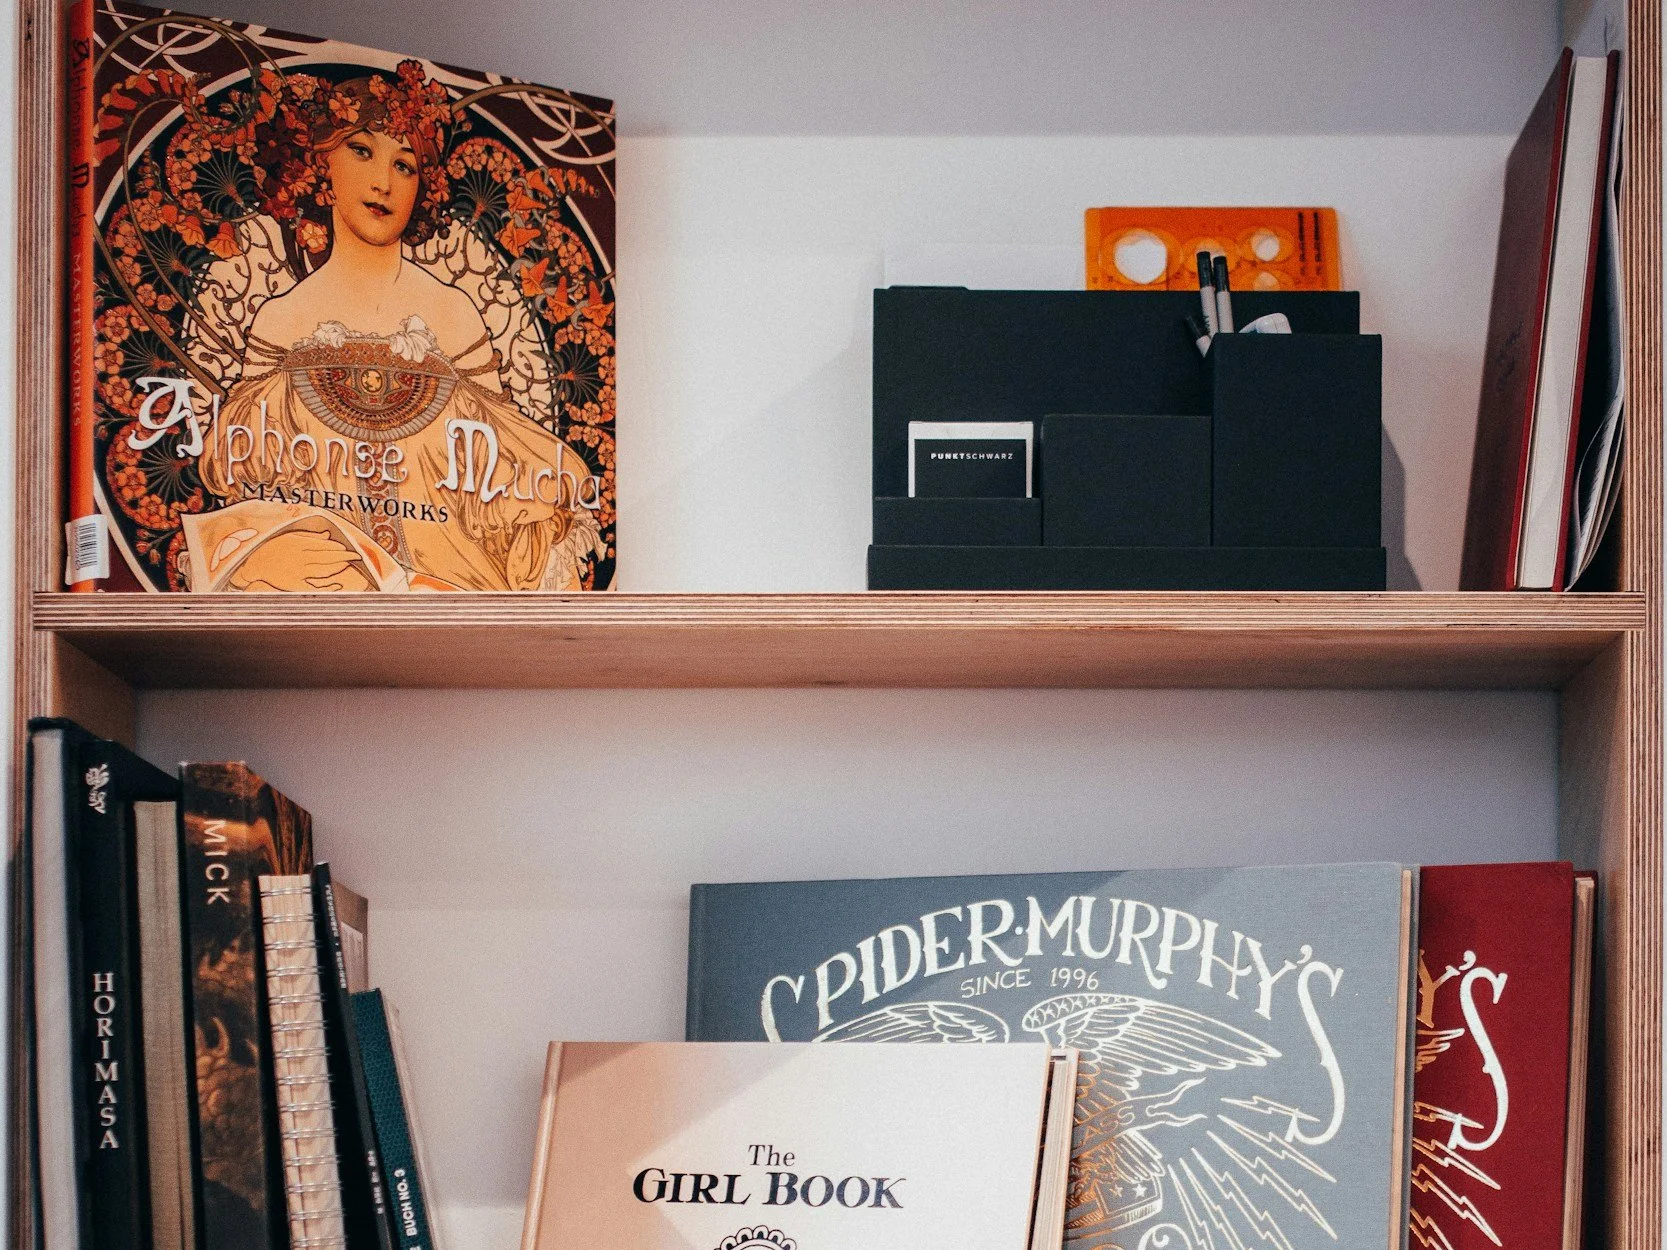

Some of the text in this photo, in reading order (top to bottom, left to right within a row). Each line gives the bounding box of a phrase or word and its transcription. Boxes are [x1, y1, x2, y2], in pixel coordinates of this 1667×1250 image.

[72, 252, 82, 428] MASTERWORKS
[127, 376, 603, 511] Alphonse Mucha
[930, 452, 1014, 461] PUNKTSCHWARZ
[241, 482, 449, 523] MASTERWORKS
[203, 819, 230, 905] MICK
[960, 967, 1100, 999] SINCE 1996
[93, 972, 119, 1149] HORIMASA
[748, 1144, 796, 1168] The
[396, 1178, 410, 1200] NO.
[632, 1167, 907, 1211] GIRL BOOK
[401, 1202, 418, 1237] BUCH
